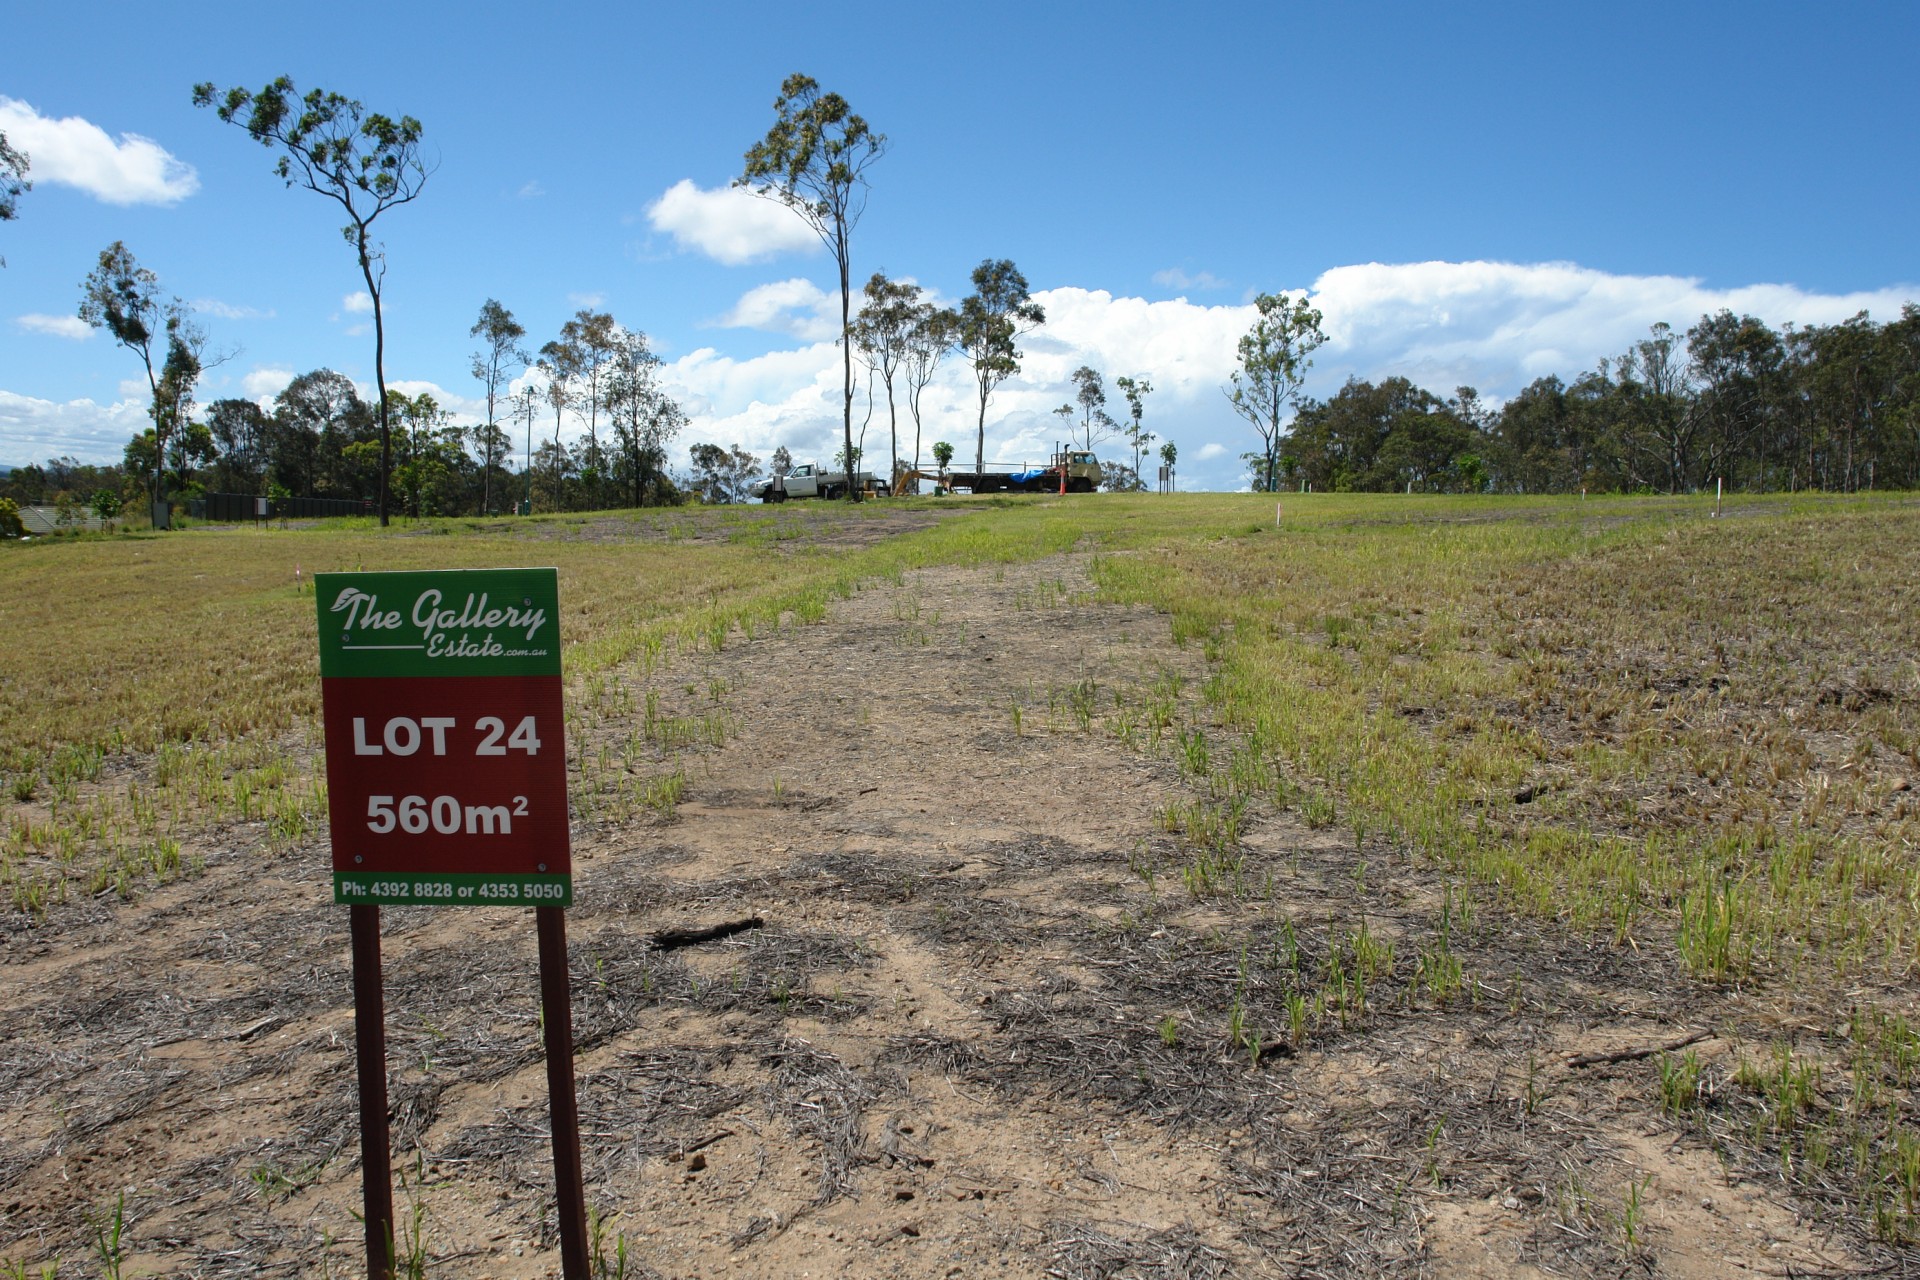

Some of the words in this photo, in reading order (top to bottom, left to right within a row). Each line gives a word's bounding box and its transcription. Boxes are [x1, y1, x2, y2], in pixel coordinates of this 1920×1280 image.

[331, 588, 403, 630] The
[412, 588, 546, 641] Gallery
[352, 716, 456, 757] LOT
[474, 715, 541, 756] 24
[341, 881, 367, 896] Ph:
[370, 882, 409, 897] 4392
[414, 883, 452, 898] 8828
[457, 886, 474, 898] or
[478, 883, 519, 899] 4353
[523, 883, 564, 899] 5050
